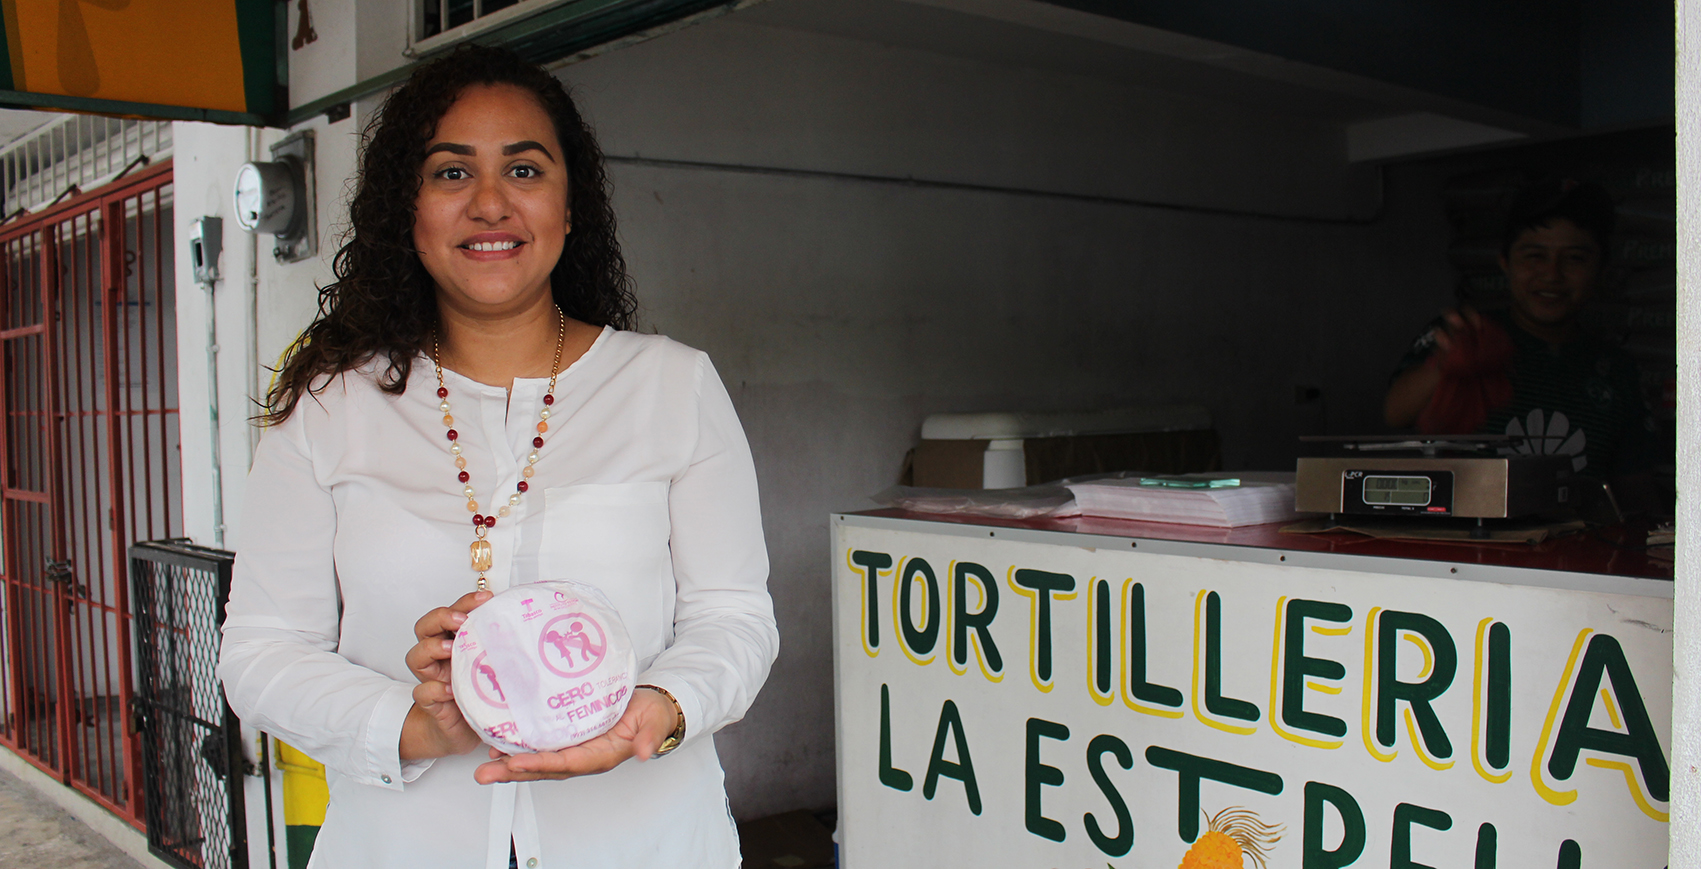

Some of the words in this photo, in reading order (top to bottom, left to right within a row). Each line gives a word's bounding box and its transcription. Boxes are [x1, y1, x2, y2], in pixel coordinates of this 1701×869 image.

[547, 681, 595, 709] CERO
[848, 549, 1670, 819] TORTILLERIA
[877, 683, 984, 818] LA
